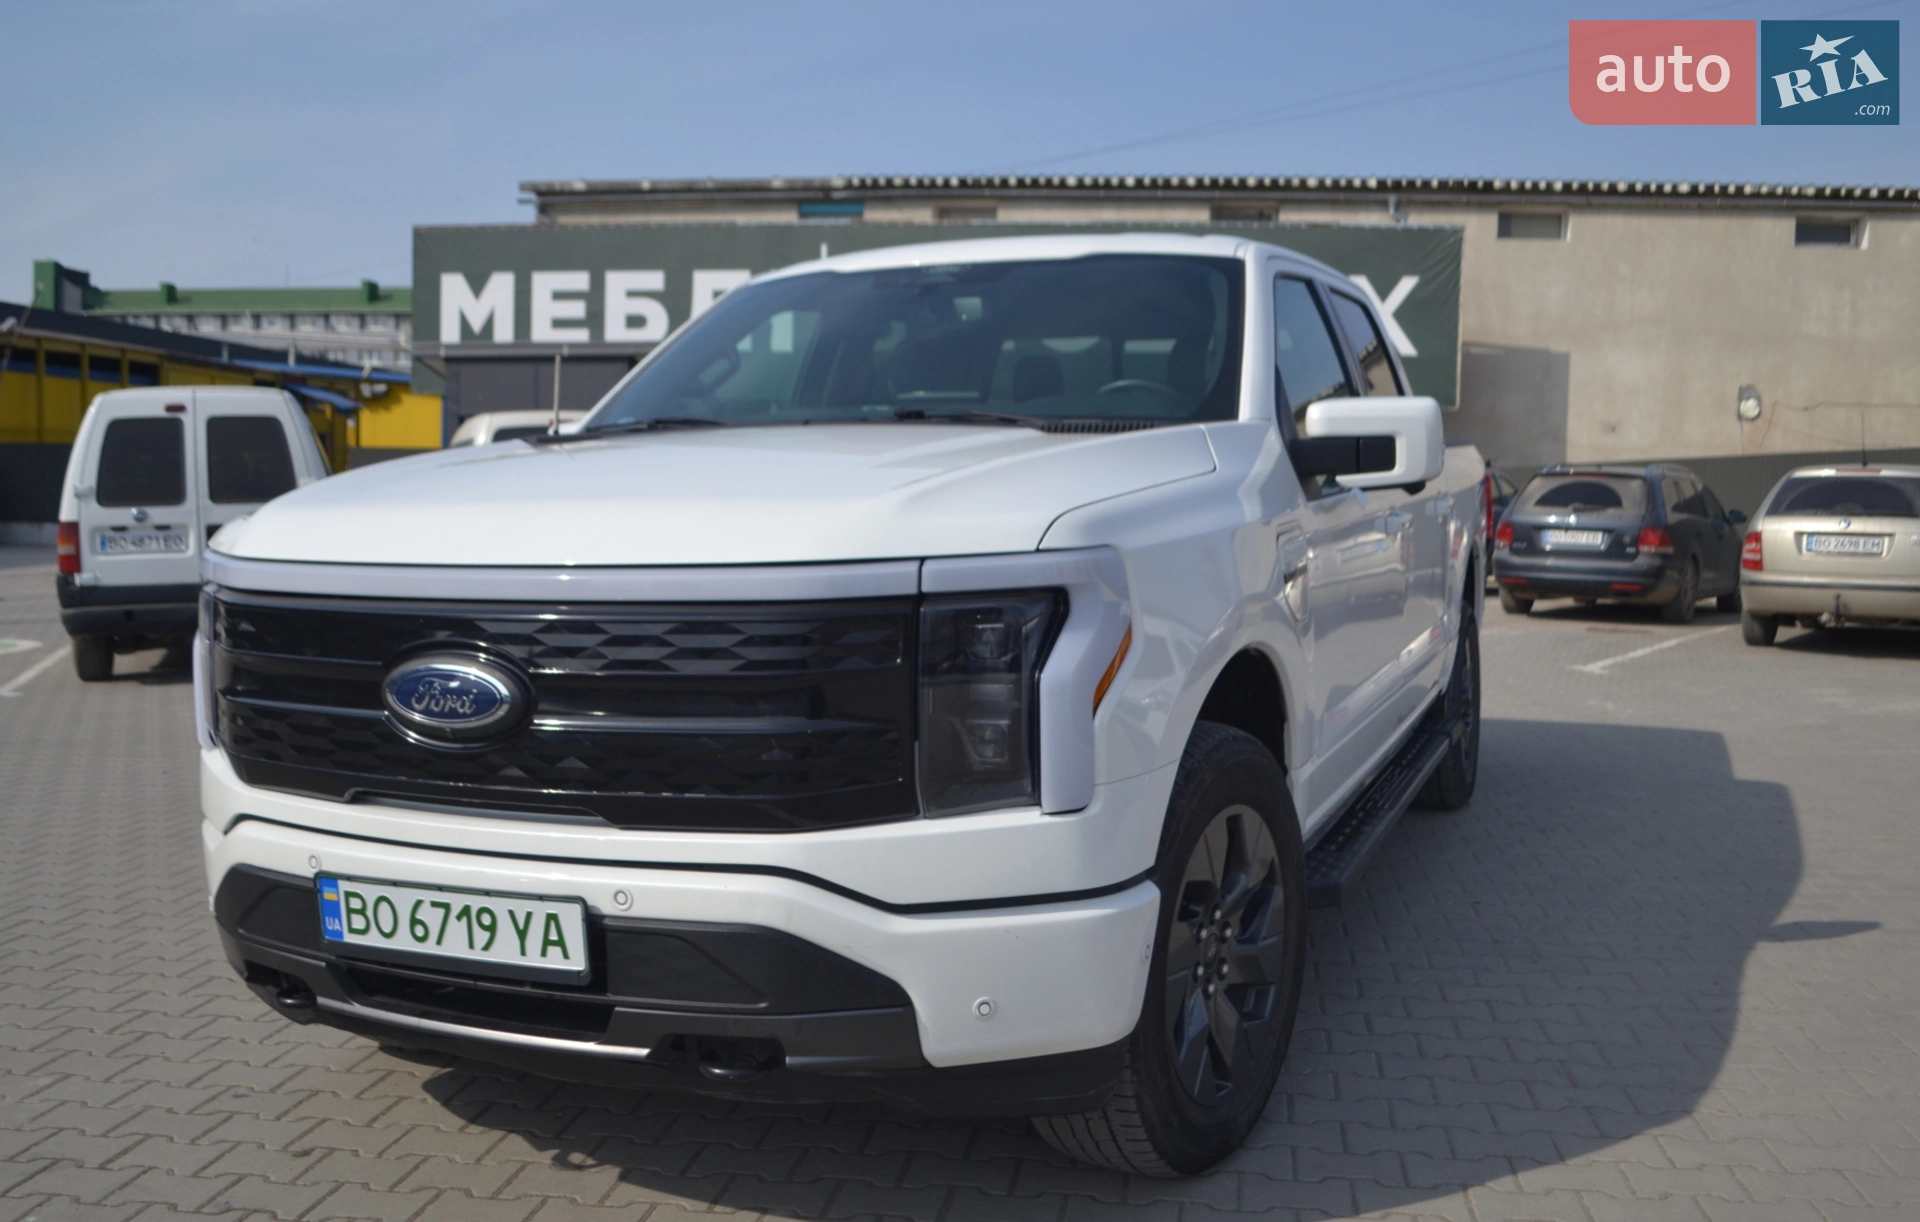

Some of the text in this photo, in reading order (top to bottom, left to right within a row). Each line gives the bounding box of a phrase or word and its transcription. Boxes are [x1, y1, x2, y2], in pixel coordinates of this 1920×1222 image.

[411, 677, 478, 714] Ford
[326, 916, 341, 931] UA
[343, 890, 570, 960] BO 6719 YA
